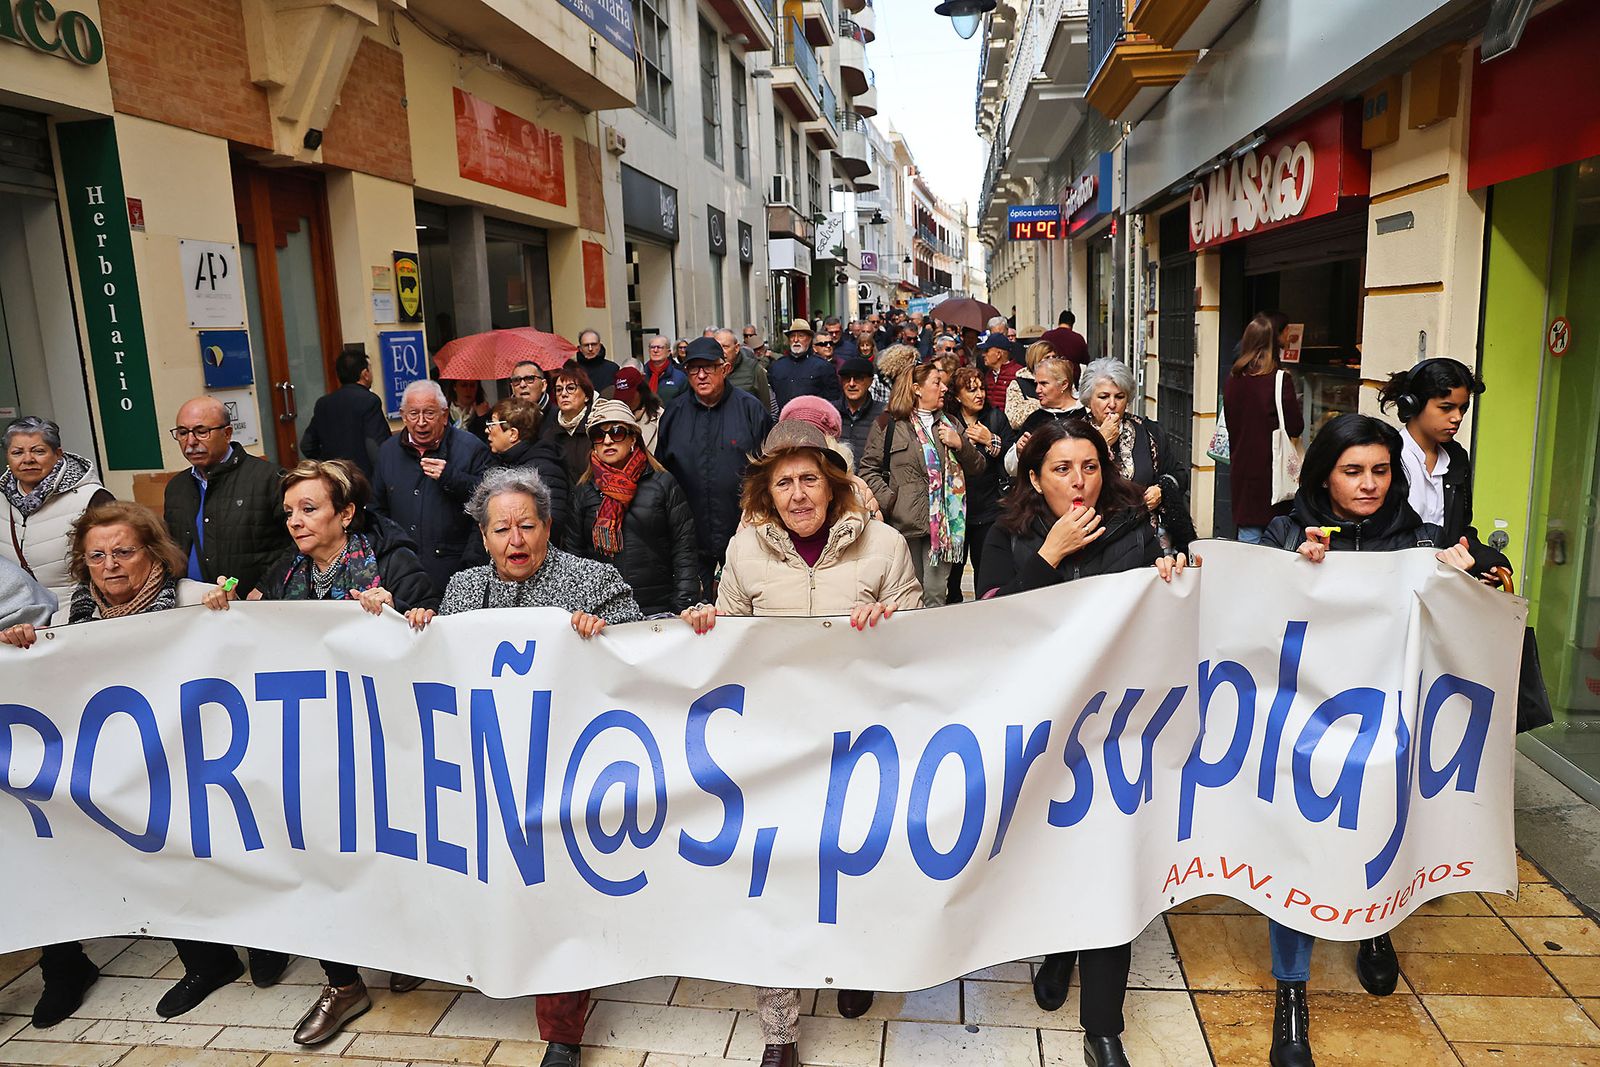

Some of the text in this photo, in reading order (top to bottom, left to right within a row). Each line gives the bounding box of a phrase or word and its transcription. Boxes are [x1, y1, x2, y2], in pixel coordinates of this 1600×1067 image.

[1010, 208, 1058, 218] óptica urbano
[1016, 222, 1031, 239] 14
[86, 186, 133, 411] Herbolario
[391, 344, 418, 376] EQ
[818, 719, 1052, 924] por
[1047, 685, 1188, 828] su
[1177, 620, 1496, 890] playa
[1162, 856, 1475, 925] AA.VV. Portileños
